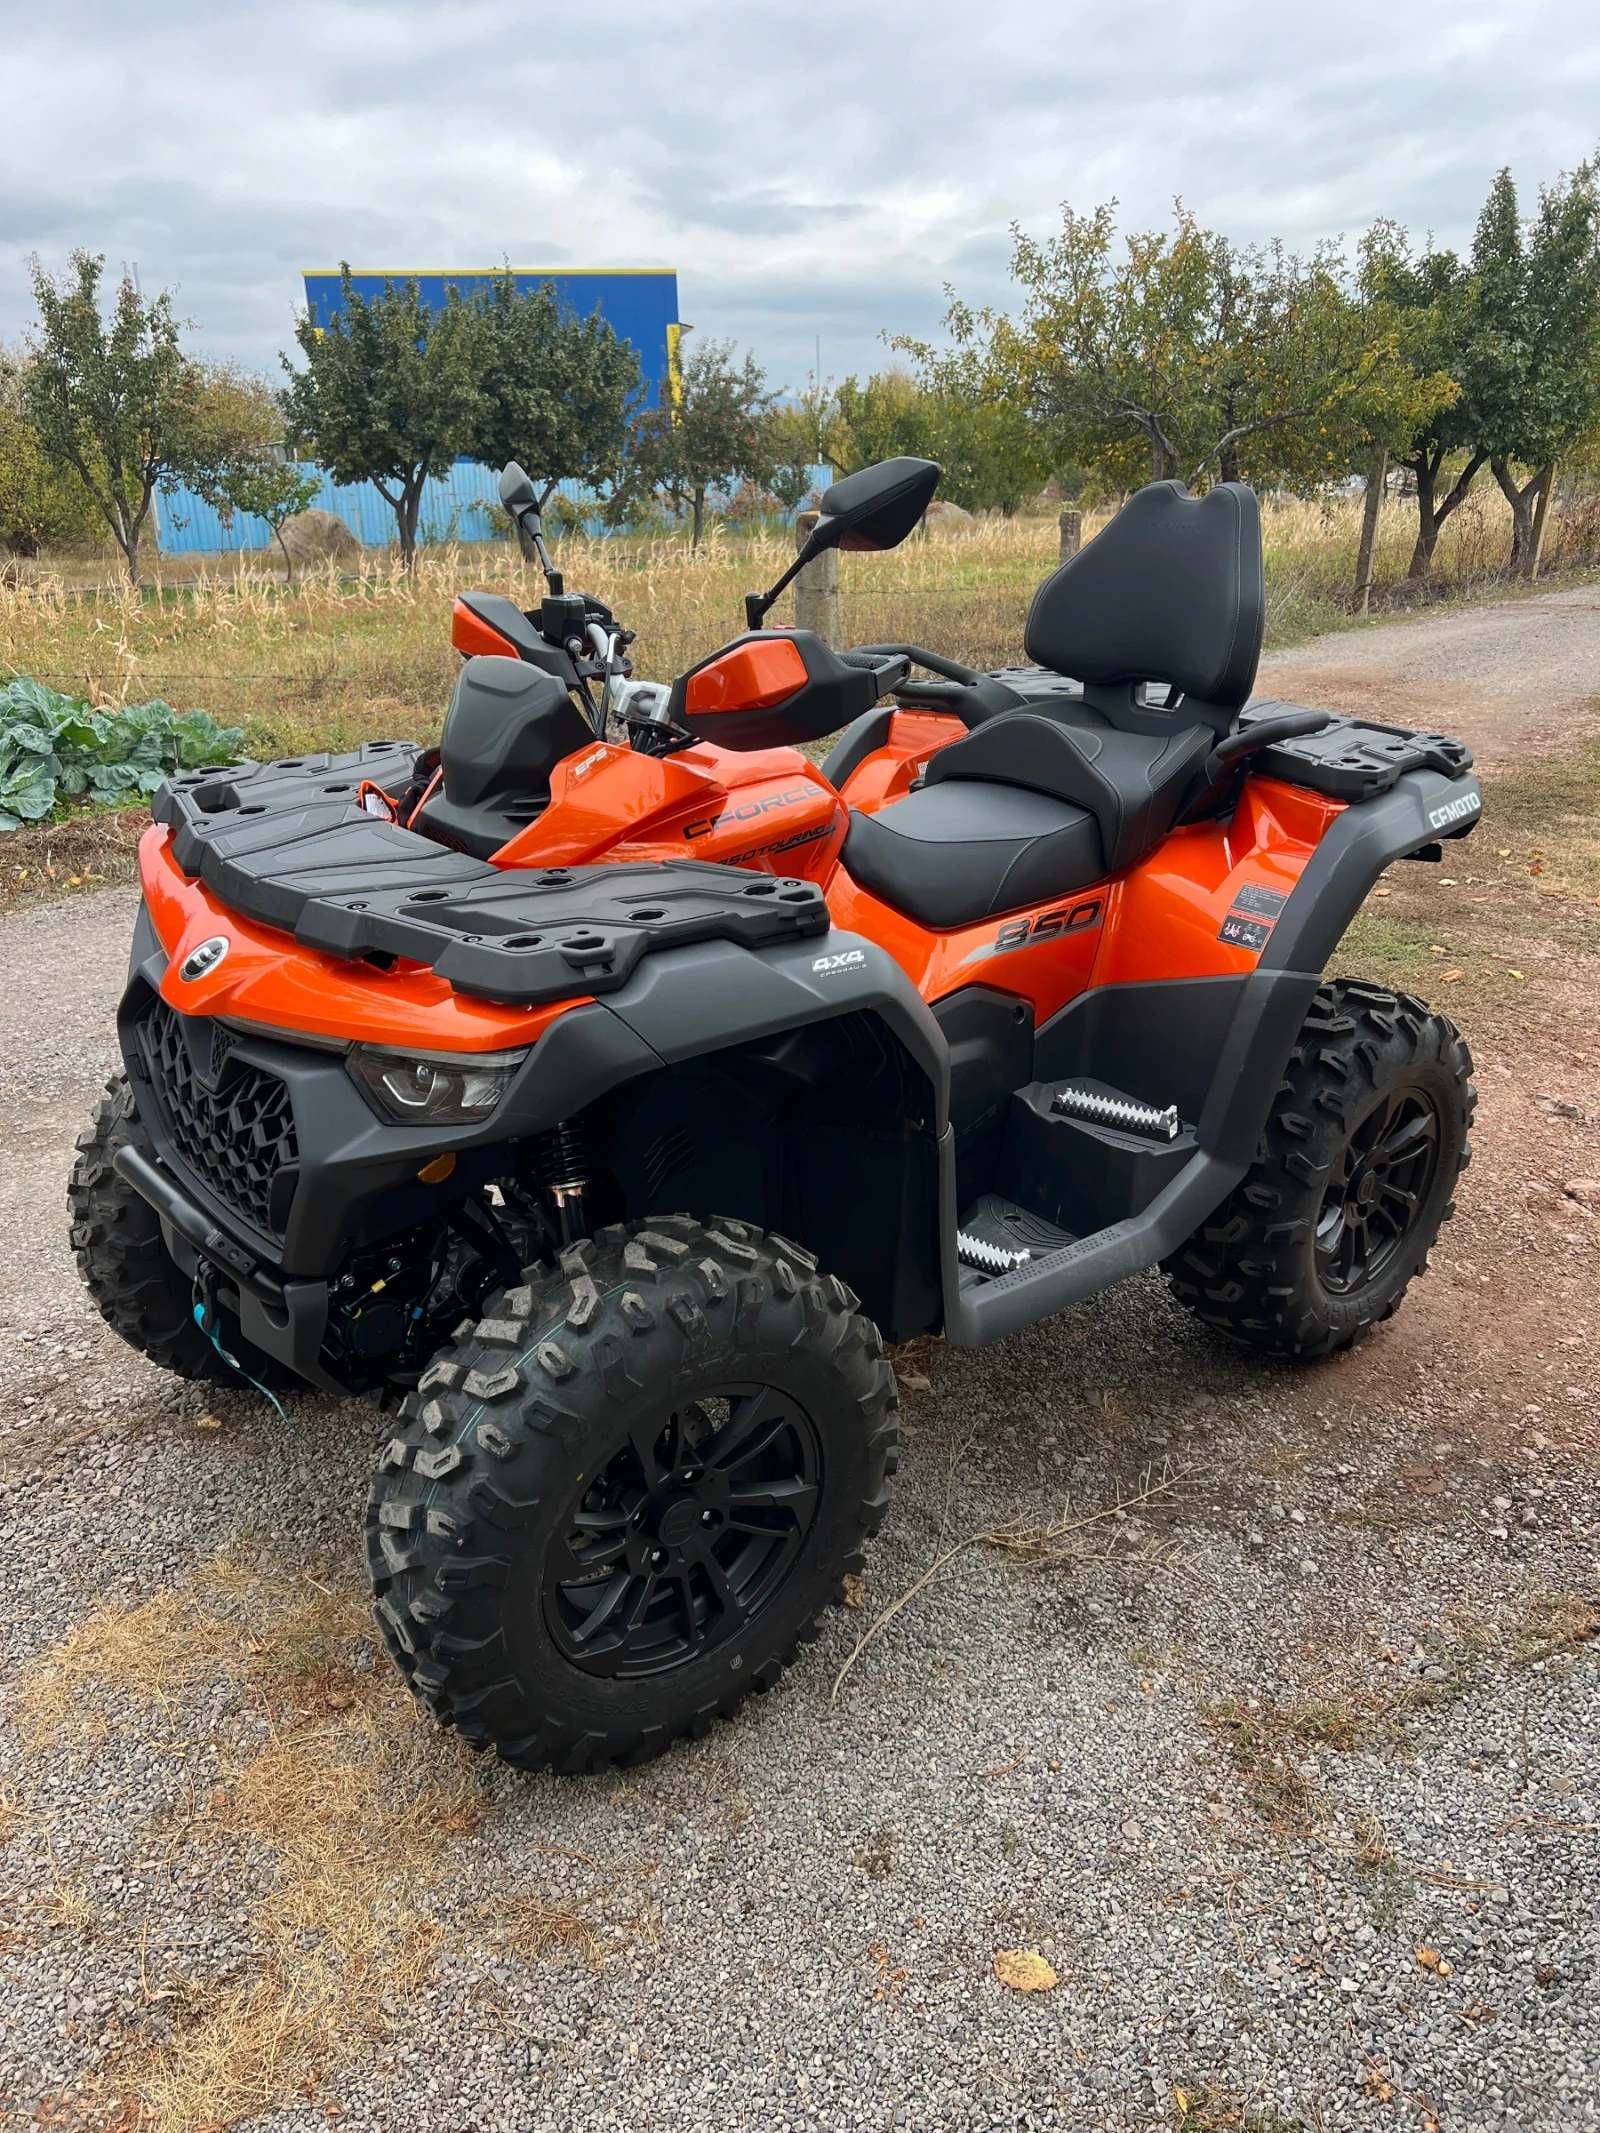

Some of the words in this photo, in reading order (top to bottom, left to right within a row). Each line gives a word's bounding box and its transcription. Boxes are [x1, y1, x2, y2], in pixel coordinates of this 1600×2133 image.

[575, 747, 607, 776] EPS
[682, 785, 825, 839] CFORCE
[1429, 792, 1481, 829] CFMOTO
[995, 897, 1104, 952] 850
